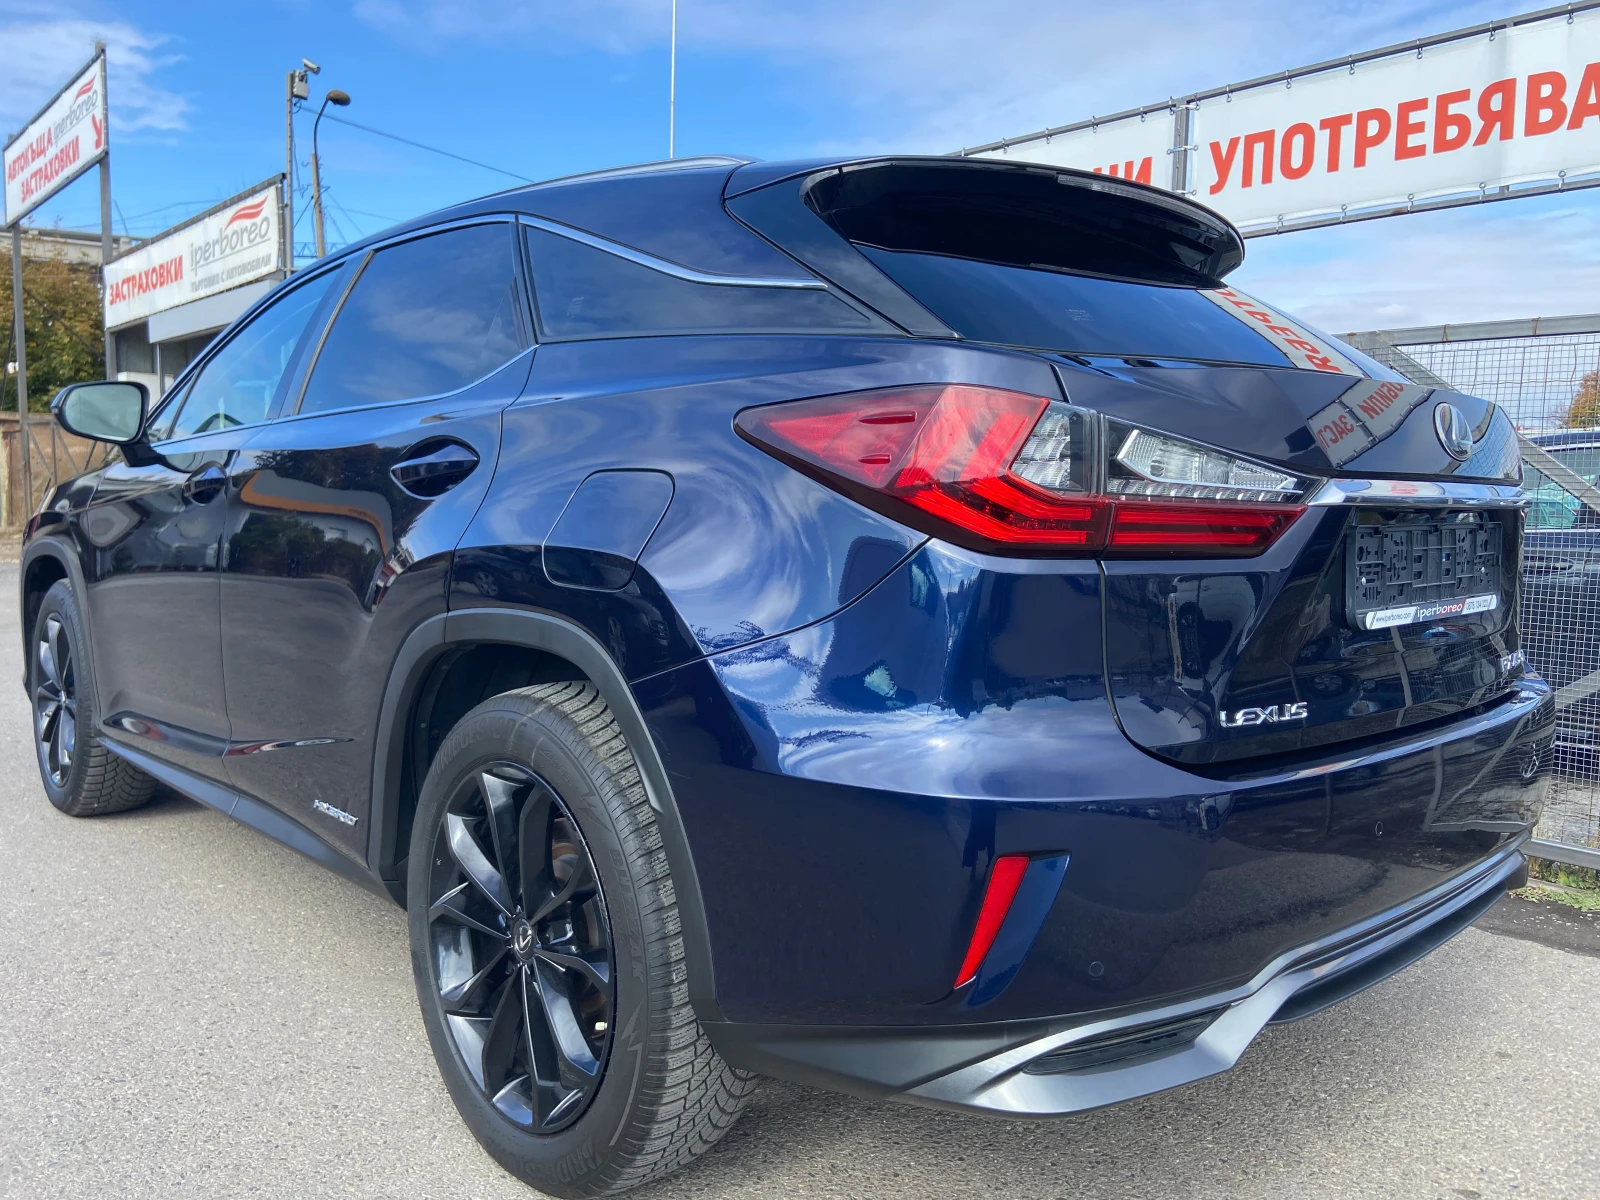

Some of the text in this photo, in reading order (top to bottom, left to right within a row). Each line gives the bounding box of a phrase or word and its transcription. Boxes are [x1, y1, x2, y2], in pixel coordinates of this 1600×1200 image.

[53, 89, 98, 147] iperboreo
[1209, 62, 1600, 195] УПОТРЕБЯВА
[8, 127, 53, 184] АВТОКЪЩА
[21, 135, 80, 204] ЗАСТРАХОВКИ
[190, 216, 270, 278] iperboreo
[109, 254, 184, 306] ЗАСТРАХОВКИ
[1417, 602, 1463, 622] iperboreo
[1219, 701, 1308, 728] LEXUS
